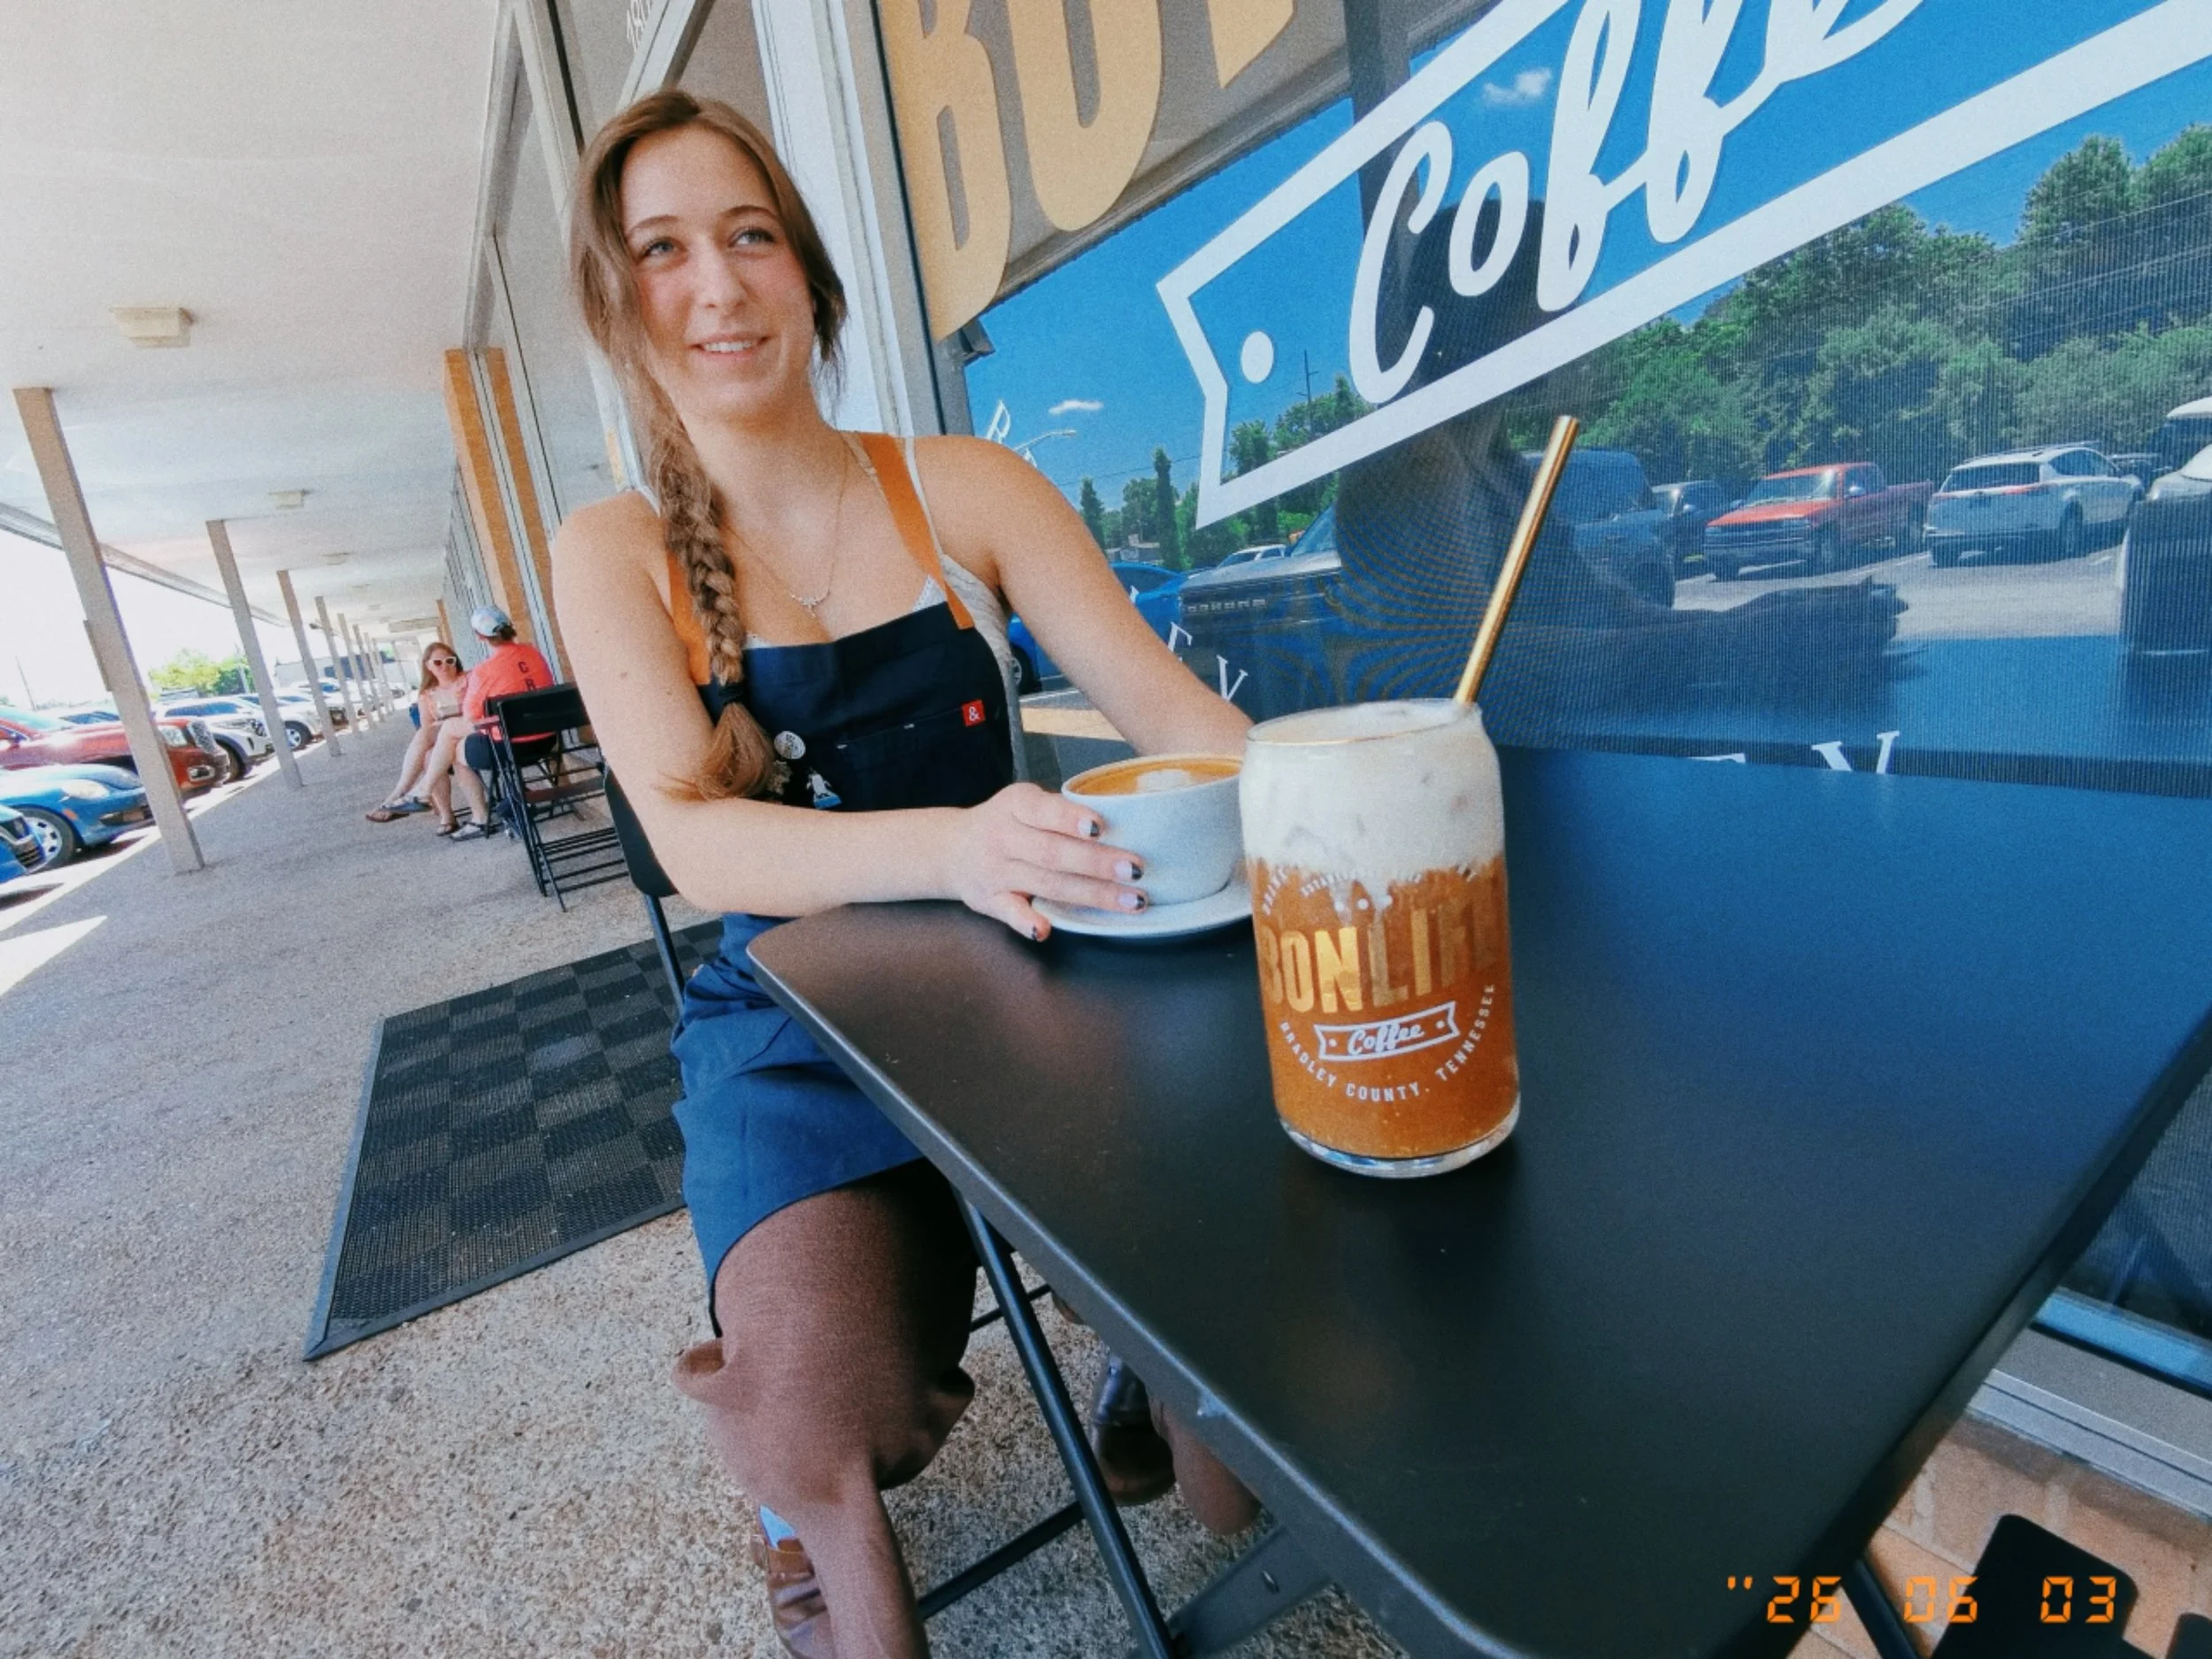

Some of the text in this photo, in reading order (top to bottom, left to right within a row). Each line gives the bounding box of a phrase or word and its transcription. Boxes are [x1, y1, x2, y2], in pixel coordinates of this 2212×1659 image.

[1349, 0, 1923, 403] Coff
[969, 706, 979, 721] &
[1279, 1021, 1337, 1087] BRADLEY
[1435, 984, 1494, 1081] TENNESSEE
[1348, 1022, 1425, 1056] Coffee
